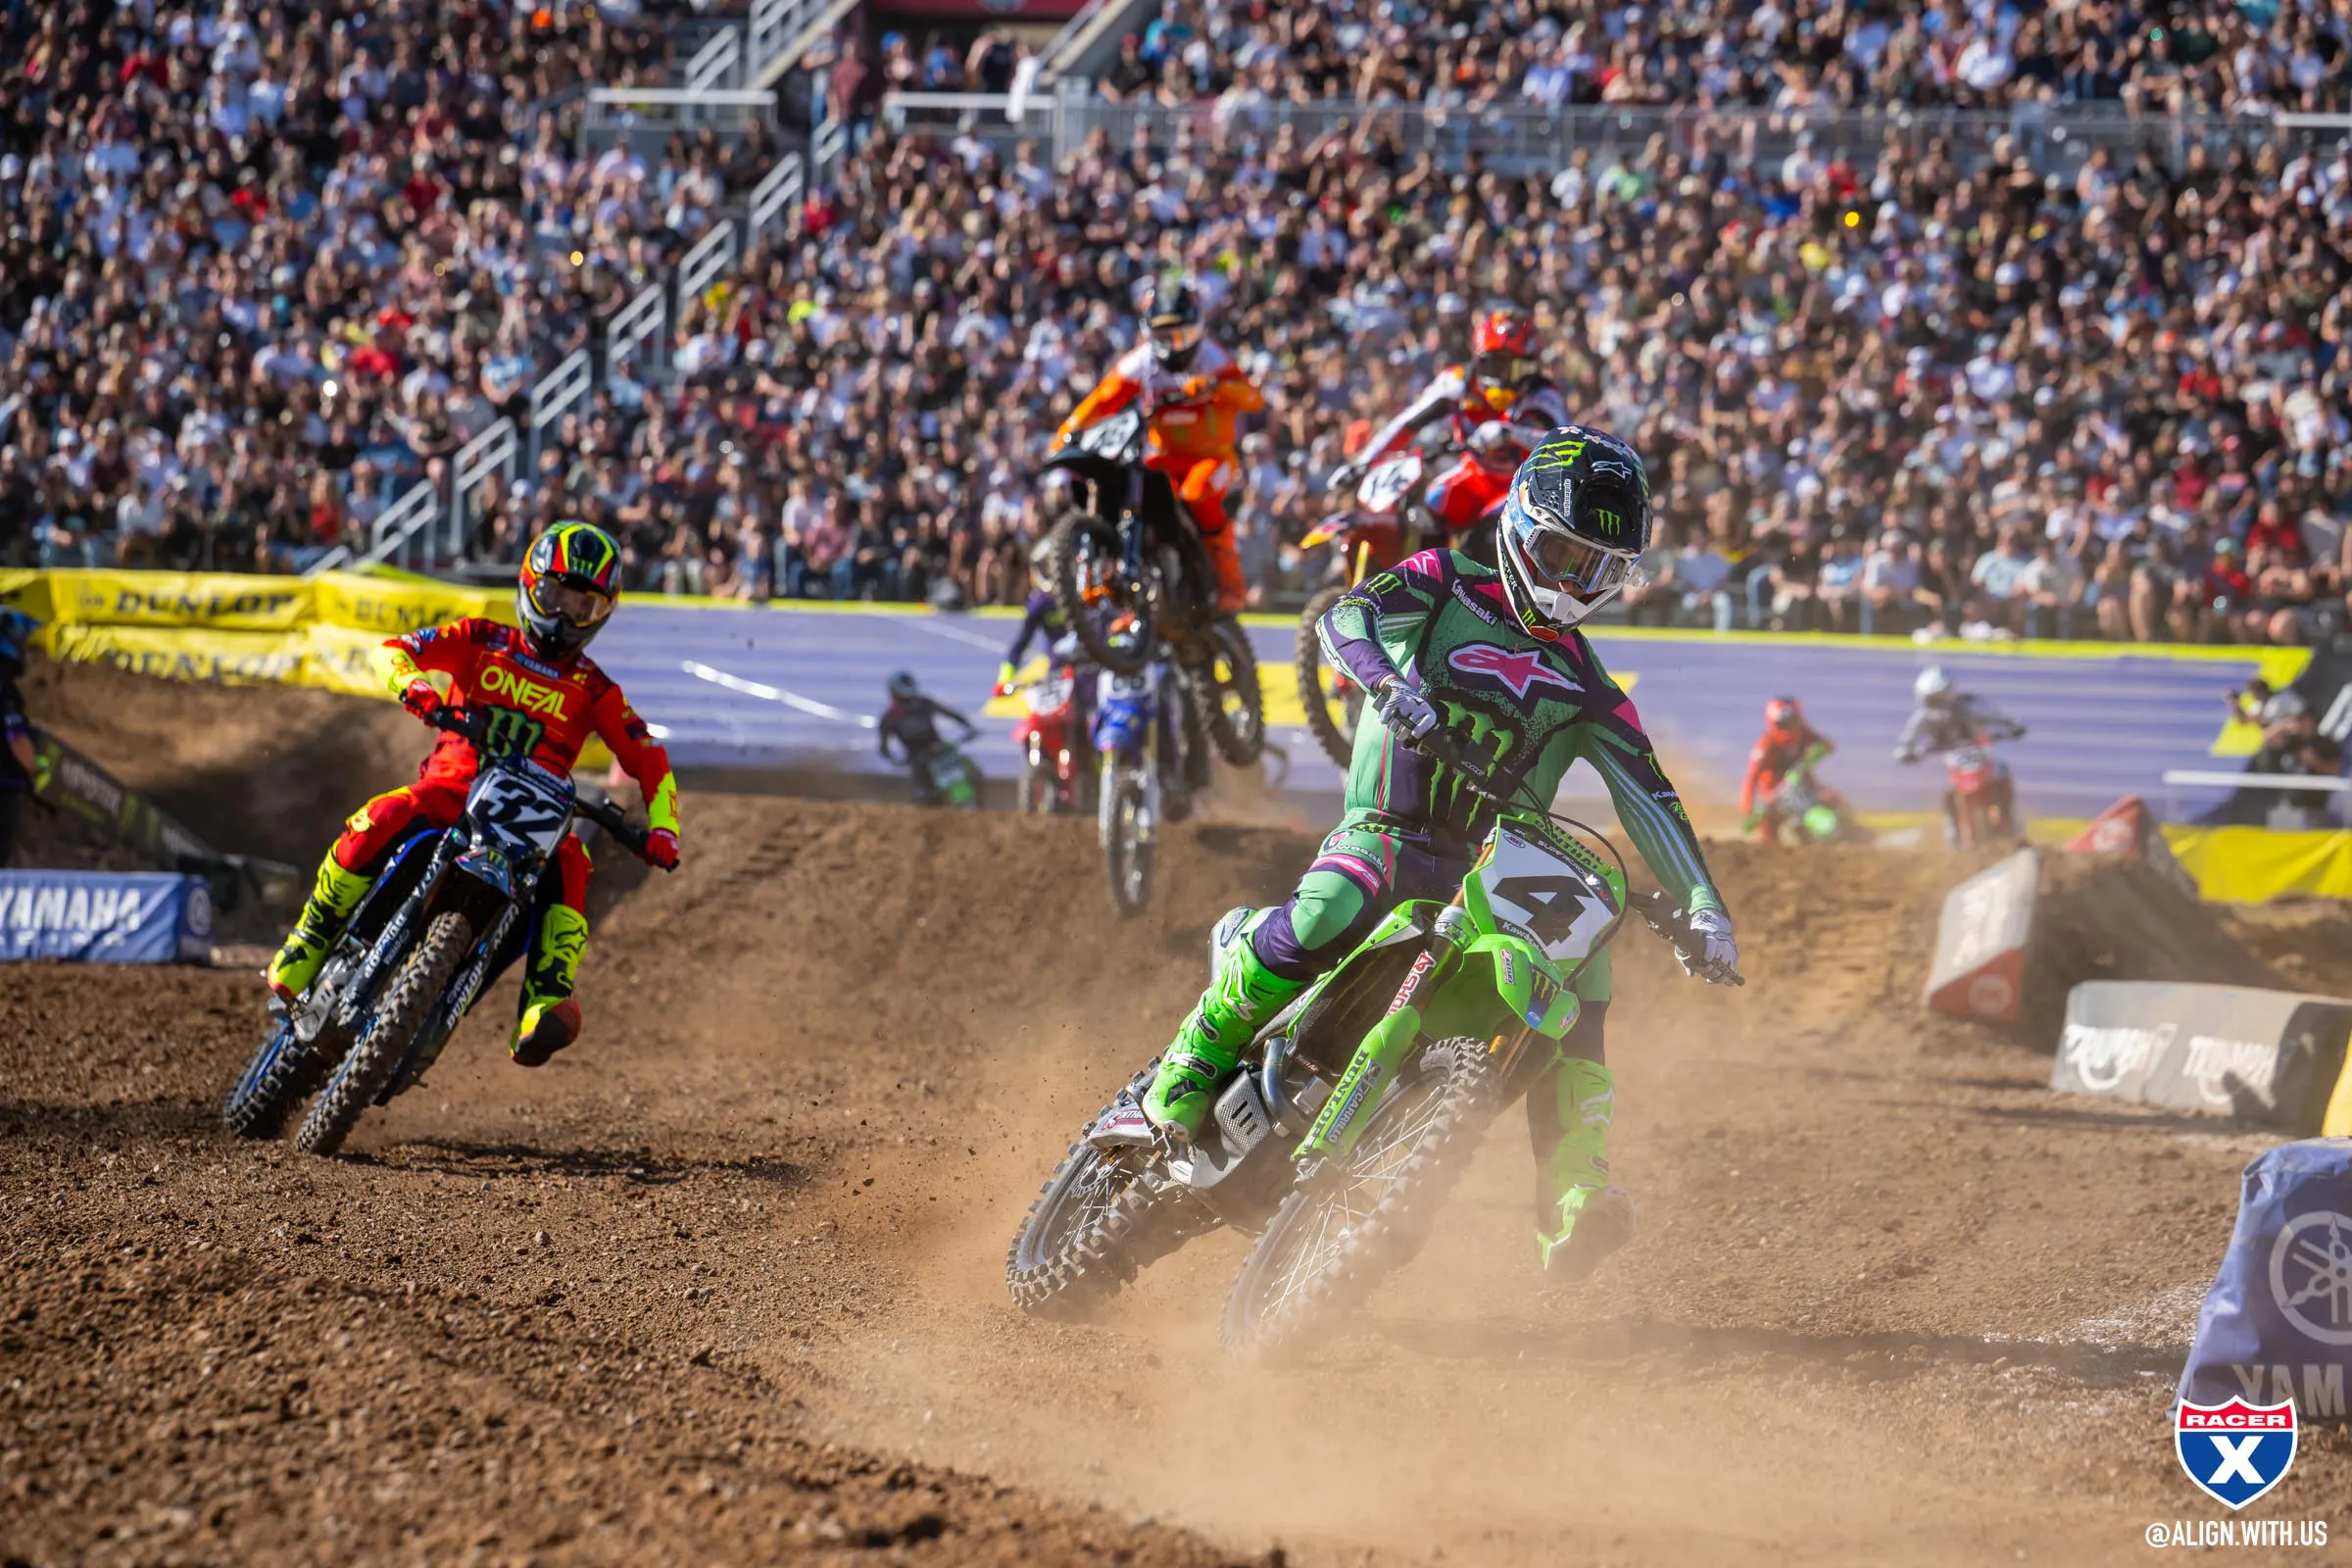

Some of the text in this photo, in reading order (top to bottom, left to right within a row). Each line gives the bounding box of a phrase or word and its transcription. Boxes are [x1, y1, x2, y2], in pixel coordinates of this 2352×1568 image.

[117, 591, 292, 617] DUNLOP
[479, 665, 569, 722] O'NEAL
[478, 778, 565, 845] 32
[1492, 875, 1595, 947] 4
[446, 959, 484, 1030] DUNLOP
[1311, 1050, 1370, 1139] DUNLOP
[1328, 1093, 1364, 1144] CARRILLO
